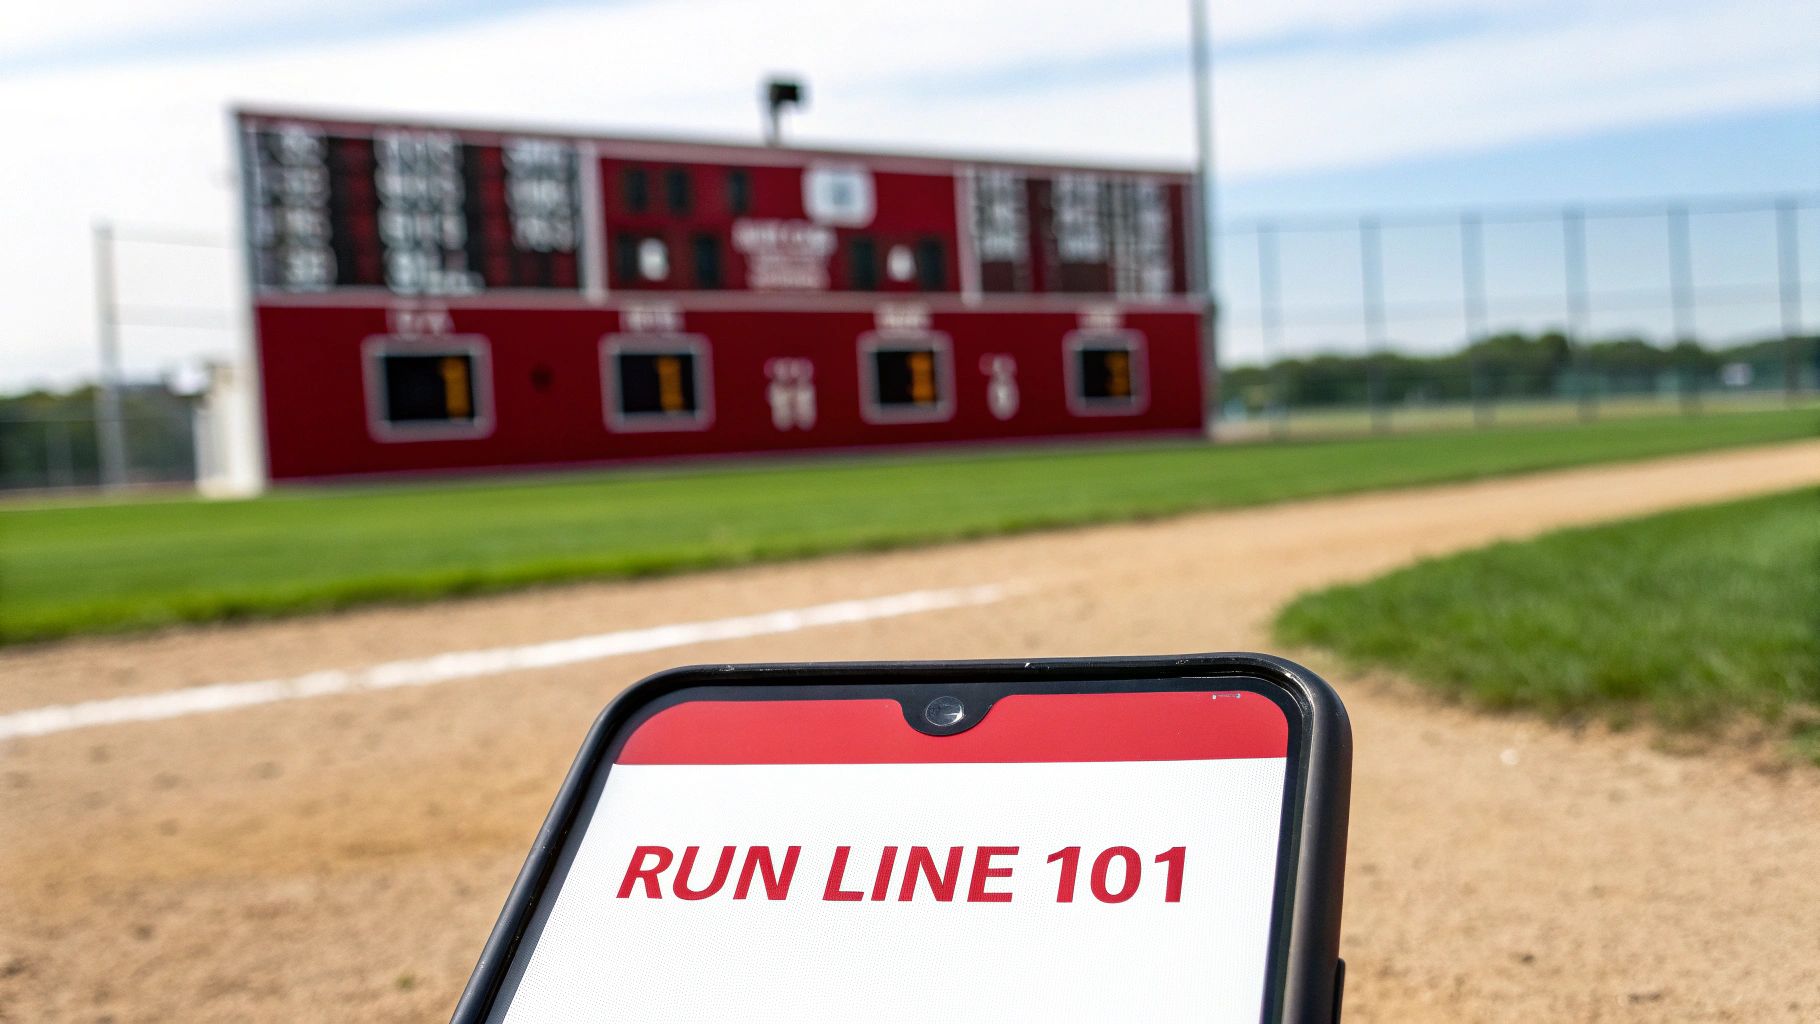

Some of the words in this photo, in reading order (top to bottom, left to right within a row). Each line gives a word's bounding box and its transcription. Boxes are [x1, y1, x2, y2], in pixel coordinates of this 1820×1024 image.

[616, 845, 801, 901] RUN
[822, 845, 1019, 903] LINE
[1046, 845, 1187, 904] 101
